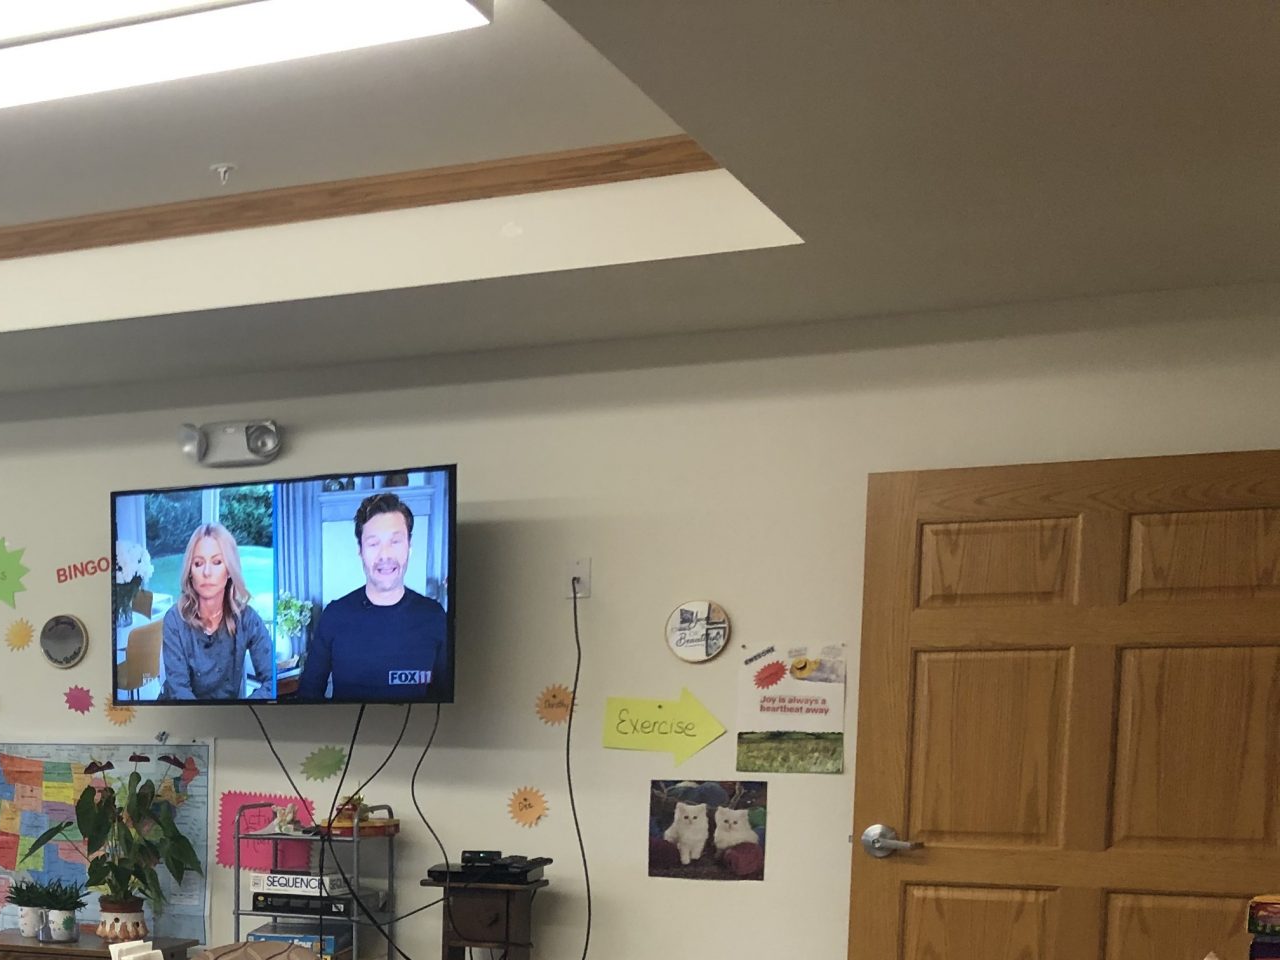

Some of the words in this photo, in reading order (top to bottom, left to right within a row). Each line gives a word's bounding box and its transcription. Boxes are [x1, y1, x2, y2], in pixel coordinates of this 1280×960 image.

[56, 556, 111, 584] BINGO
[390, 671, 418, 685] FOX
[419, 671, 432, 684] 11
[760, 696, 777, 705] Joy
[778, 696, 786, 704] is
[787, 697, 819, 706] always
[760, 705, 803, 714] heartbeat
[804, 706, 830, 716] away
[615, 708, 697, 737] Exercise
